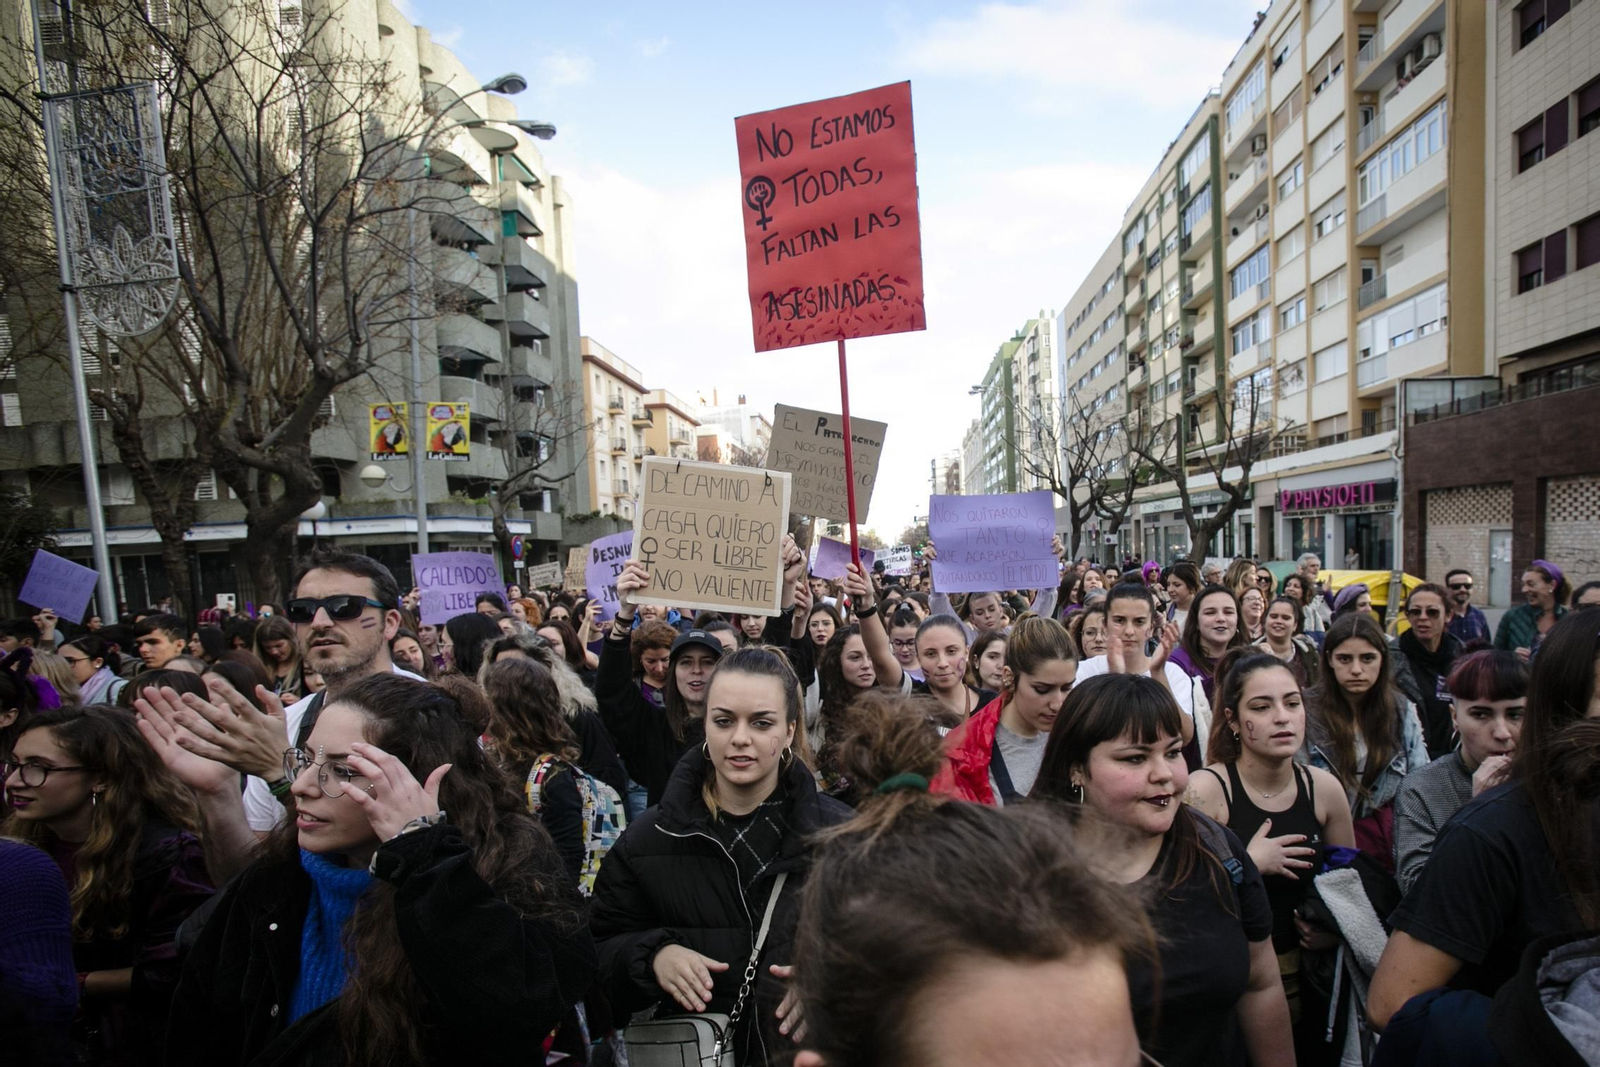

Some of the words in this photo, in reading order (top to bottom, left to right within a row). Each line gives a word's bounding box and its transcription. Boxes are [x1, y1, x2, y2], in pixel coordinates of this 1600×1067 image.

[755, 122, 794, 162] NO
[810, 104, 895, 149] ESTAMOS
[782, 157, 883, 207] TODAS,
[760, 222, 839, 265] FALTAN
[854, 205, 901, 239] LAS
[783, 411, 804, 432] EL
[794, 441, 817, 453] NOS
[858, 454, 871, 465] EL
[651, 469, 677, 494] DE
[683, 474, 750, 502] CAMINO
[758, 482, 777, 506] A
[1294, 481, 1376, 508] PHYSIOFIT
[793, 490, 848, 517] IBRES
[933, 502, 959, 523] NOS
[967, 506, 1028, 522] QUITARON
[642, 509, 699, 535] CASA
[706, 513, 775, 544] QUIERO
[956, 525, 1026, 546] TANTO
[592, 543, 632, 565] DESNU
[663, 538, 702, 561] SER
[713, 541, 767, 569] LIBRE
[937, 550, 957, 564] QUE
[966, 548, 1026, 563] ACABARON
[420, 565, 487, 587] CALLADO
[652, 568, 683, 592] NO
[693, 573, 774, 602] VALIENTE
[1006, 566, 1015, 582] EL
[1020, 564, 1048, 582] MIEDO
